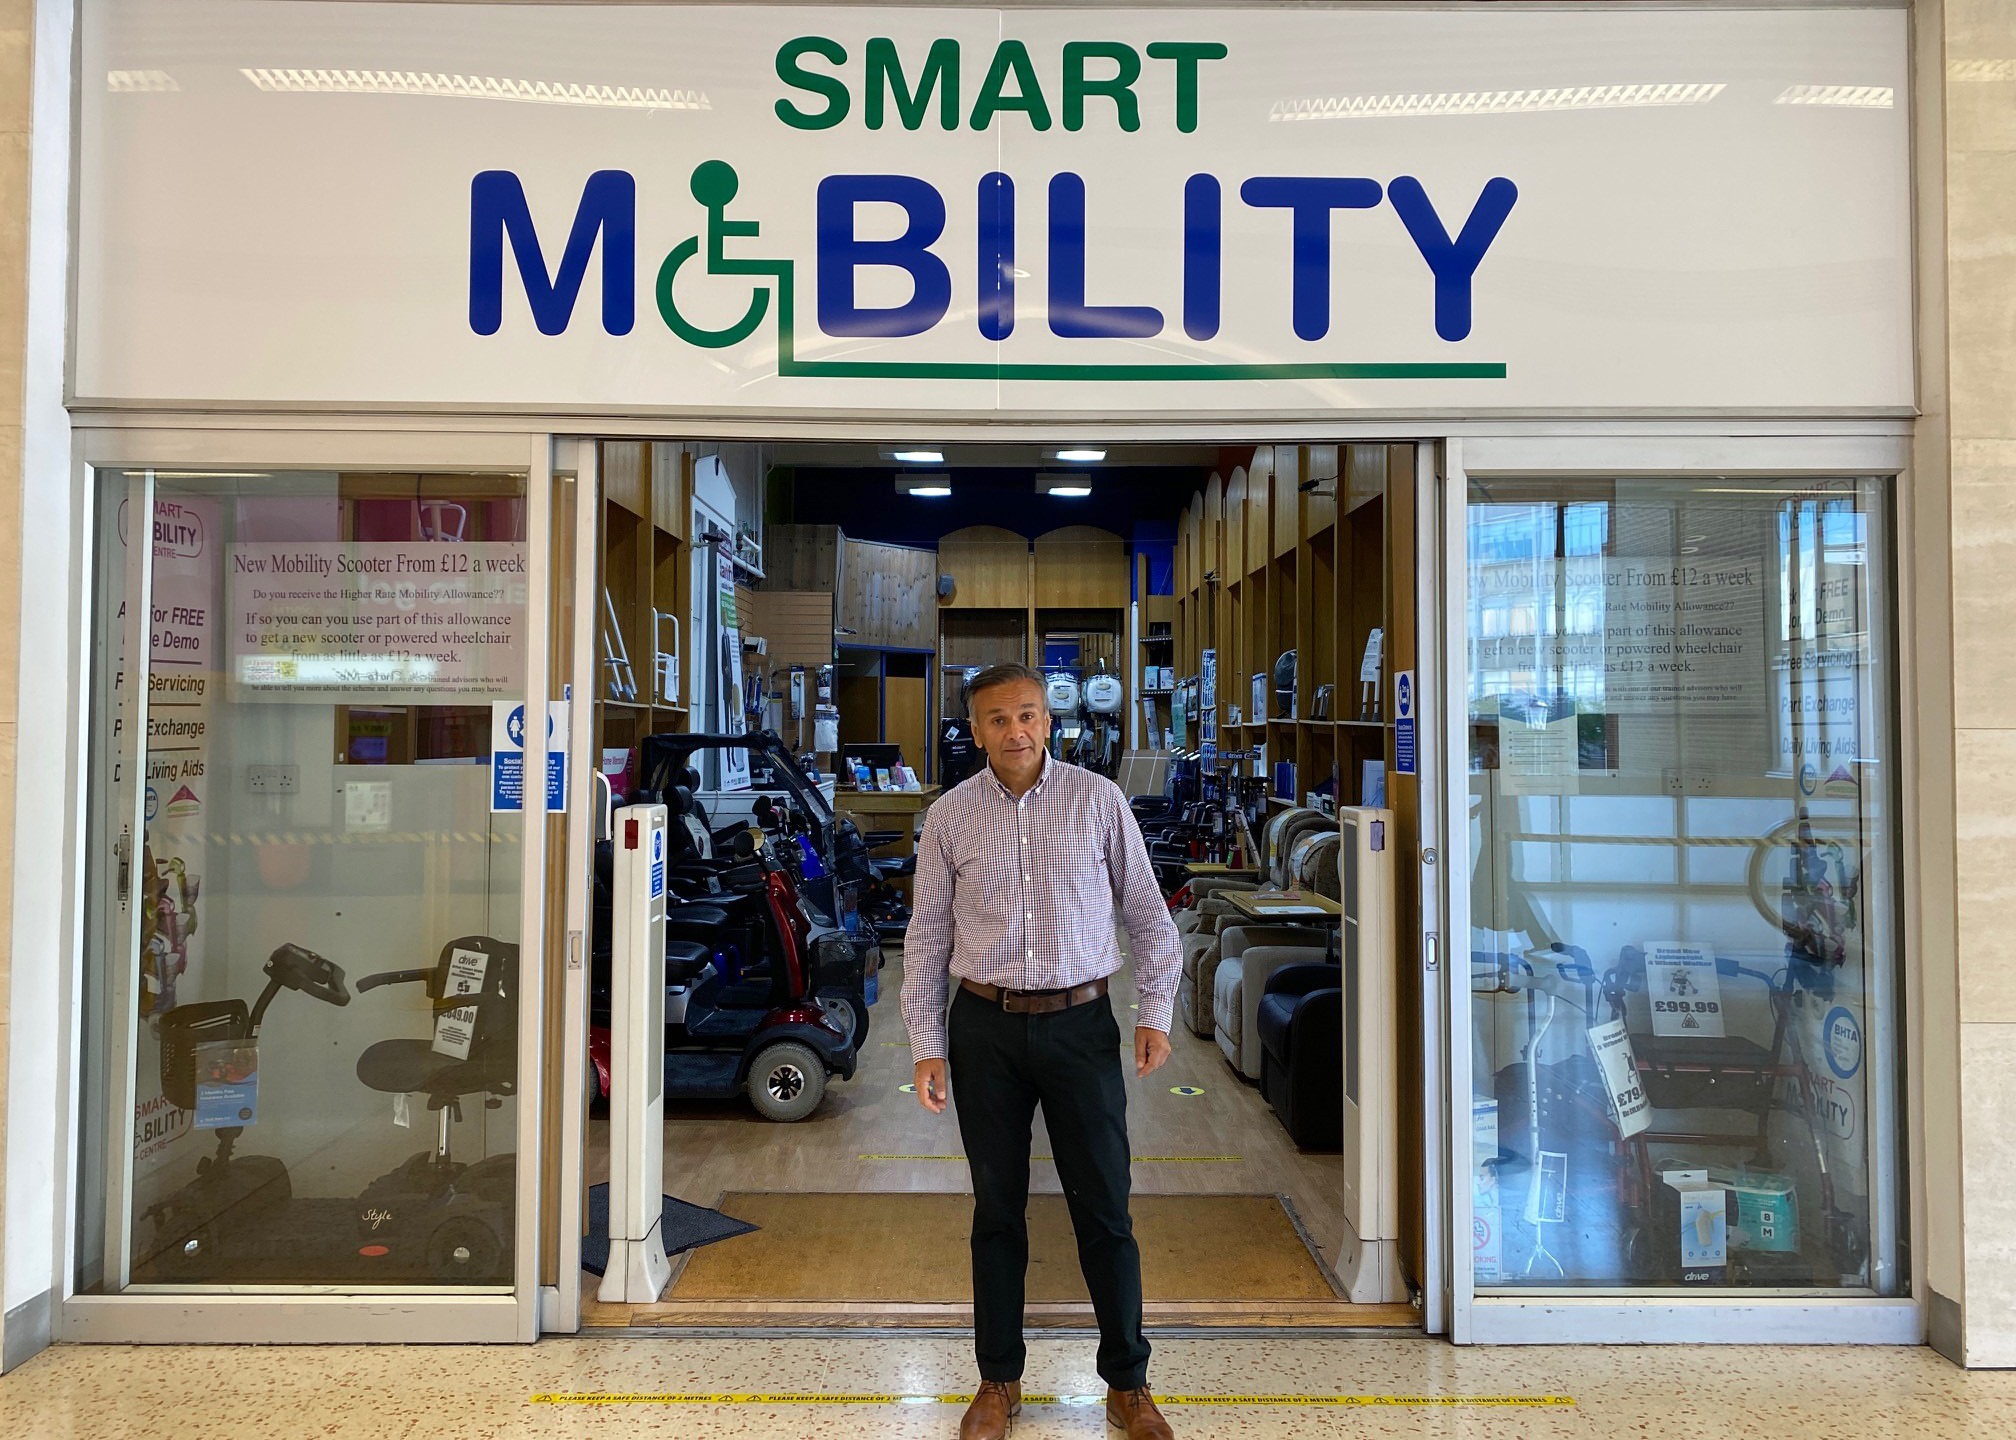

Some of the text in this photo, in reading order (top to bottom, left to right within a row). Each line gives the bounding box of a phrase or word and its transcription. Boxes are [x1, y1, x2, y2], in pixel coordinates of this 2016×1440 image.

[775, 36, 1228, 133] SMART
[153, 521, 197, 546] BILITY
[153, 546, 176, 558] ENTRE
[234, 554, 525, 577] New Mobility Scooter From £12 a week
[1467, 568, 1753, 589] ew Mobility Scooter From £12 a week
[253, 589, 504, 602] Do you receive the Higher Rate Mobility Allowance??
[1821, 578, 1849, 600] FREE
[172, 607, 205, 626] FREE
[1605, 602, 1627, 611] Rate
[1630, 602, 1670, 613] Mobility
[1674, 602, 1735, 611] Allowance??
[1817, 607, 1846, 624] Demo
[245, 613, 511, 628] If so you can you use part of this allowance
[163, 631, 199, 650] Demo
[246, 631, 511, 646] to get a new scooter or powered wheelchair
[1607, 625, 1742, 639] part of this allowance
[291, 650, 462, 662] from as little as £12 a week.
[1484, 645, 1503, 658] get
[1508, 647, 1514, 655] a
[1550, 645, 1595, 655] scooter
[1600, 646, 1611, 655] or
[1617, 642, 1670, 657] powered
[1675, 642, 1743, 655] wheelchair
[1552, 664, 1563, 672] as
[1604, 664, 1616, 672] as
[1620, 661, 1643, 672] £12
[1648, 664, 1654, 672] a
[1659, 661, 1695, 672] week.
[1782, 651, 1852, 671] Free Servicing
[149, 673, 205, 696] Servicing
[426, 685, 456, 693] questions
[1782, 694, 1855, 715] Part Exchange
[148, 718, 205, 739] Exchange
[1783, 737, 1856, 758] Daily Living Aids
[181, 759, 204, 778] Aids
[458, 955, 478, 966] drive
[1655, 1001, 1719, 1014] £99.99
[1834, 1024, 1858, 1042] BHTA
[1813, 1074, 1835, 1094] ART
[136, 1096, 168, 1120] SMAR
[140, 1138, 167, 1160] CENTRE
[362, 1209, 392, 1230] Style
[1763, 1227, 1772, 1236] M
[1474, 1256, 1498, 1264] OKING.
[1684, 1272, 1710, 1281] drive
